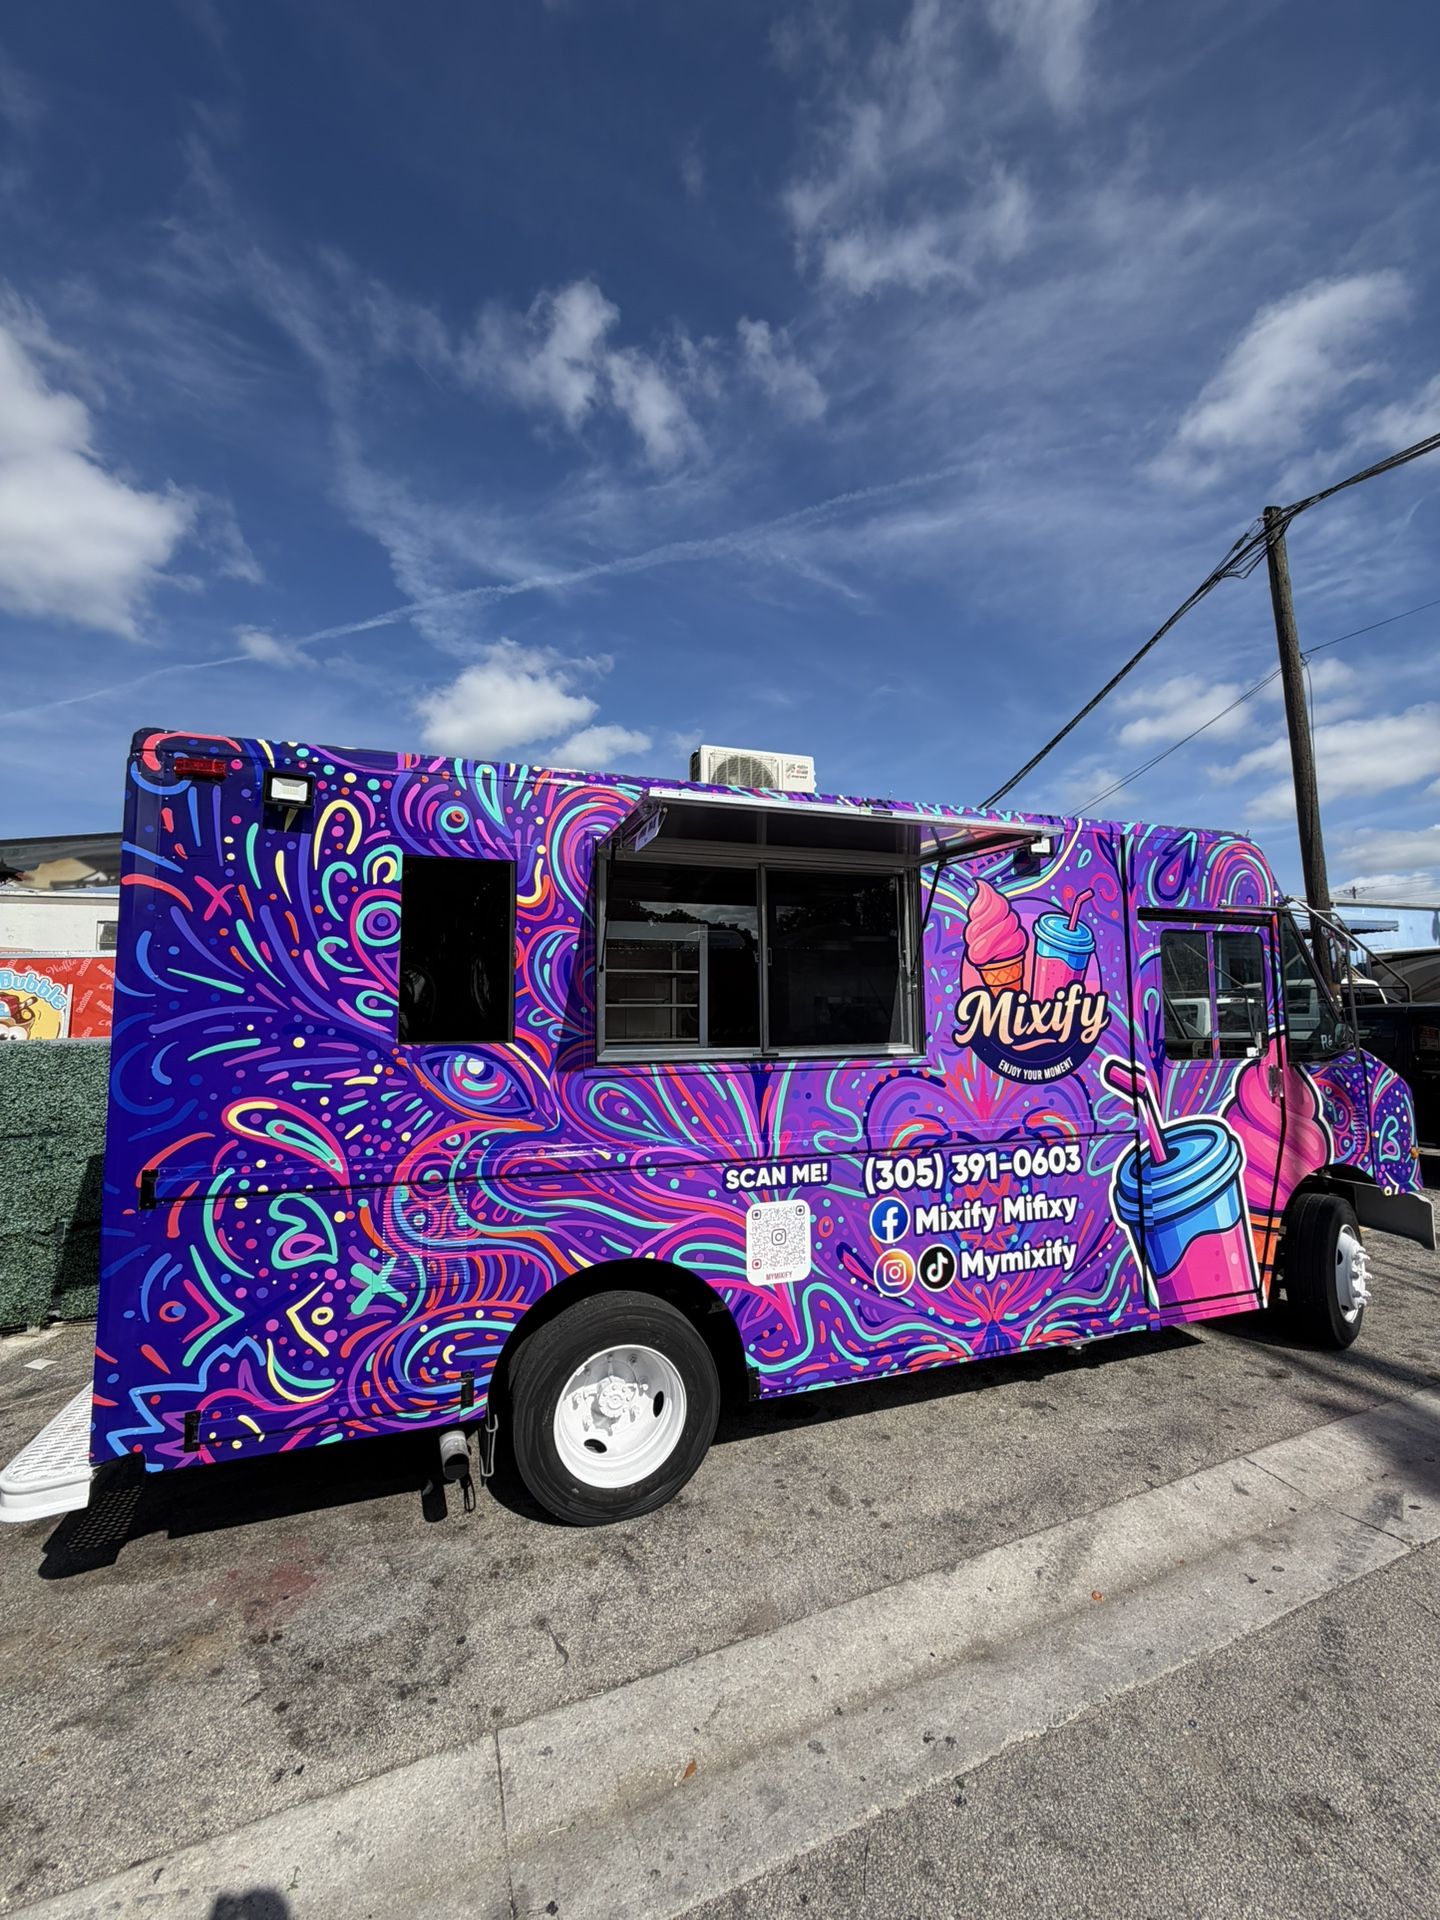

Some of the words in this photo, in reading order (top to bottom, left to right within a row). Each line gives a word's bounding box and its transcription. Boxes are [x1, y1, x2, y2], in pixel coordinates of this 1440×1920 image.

[0, 970, 68, 1010] Bubble
[954, 983, 1110, 1044] Mixify
[998, 1059, 1022, 1078] ENJOY
[1023, 1069, 1043, 1080] YOUR
[1044, 1056, 1073, 1079] MOMENT
[725, 1164, 786, 1190] SCAN
[791, 1162, 828, 1184] ME!
[865, 1153, 944, 1194] (305)
[951, 1145, 1081, 1184] 391-0603
[914, 1200, 997, 1234] Mixify
[1003, 1194, 1078, 1224] Mifixy
[765, 1271, 793, 1281] MYMIXIFY
[960, 1239, 1078, 1281] Mymixify
